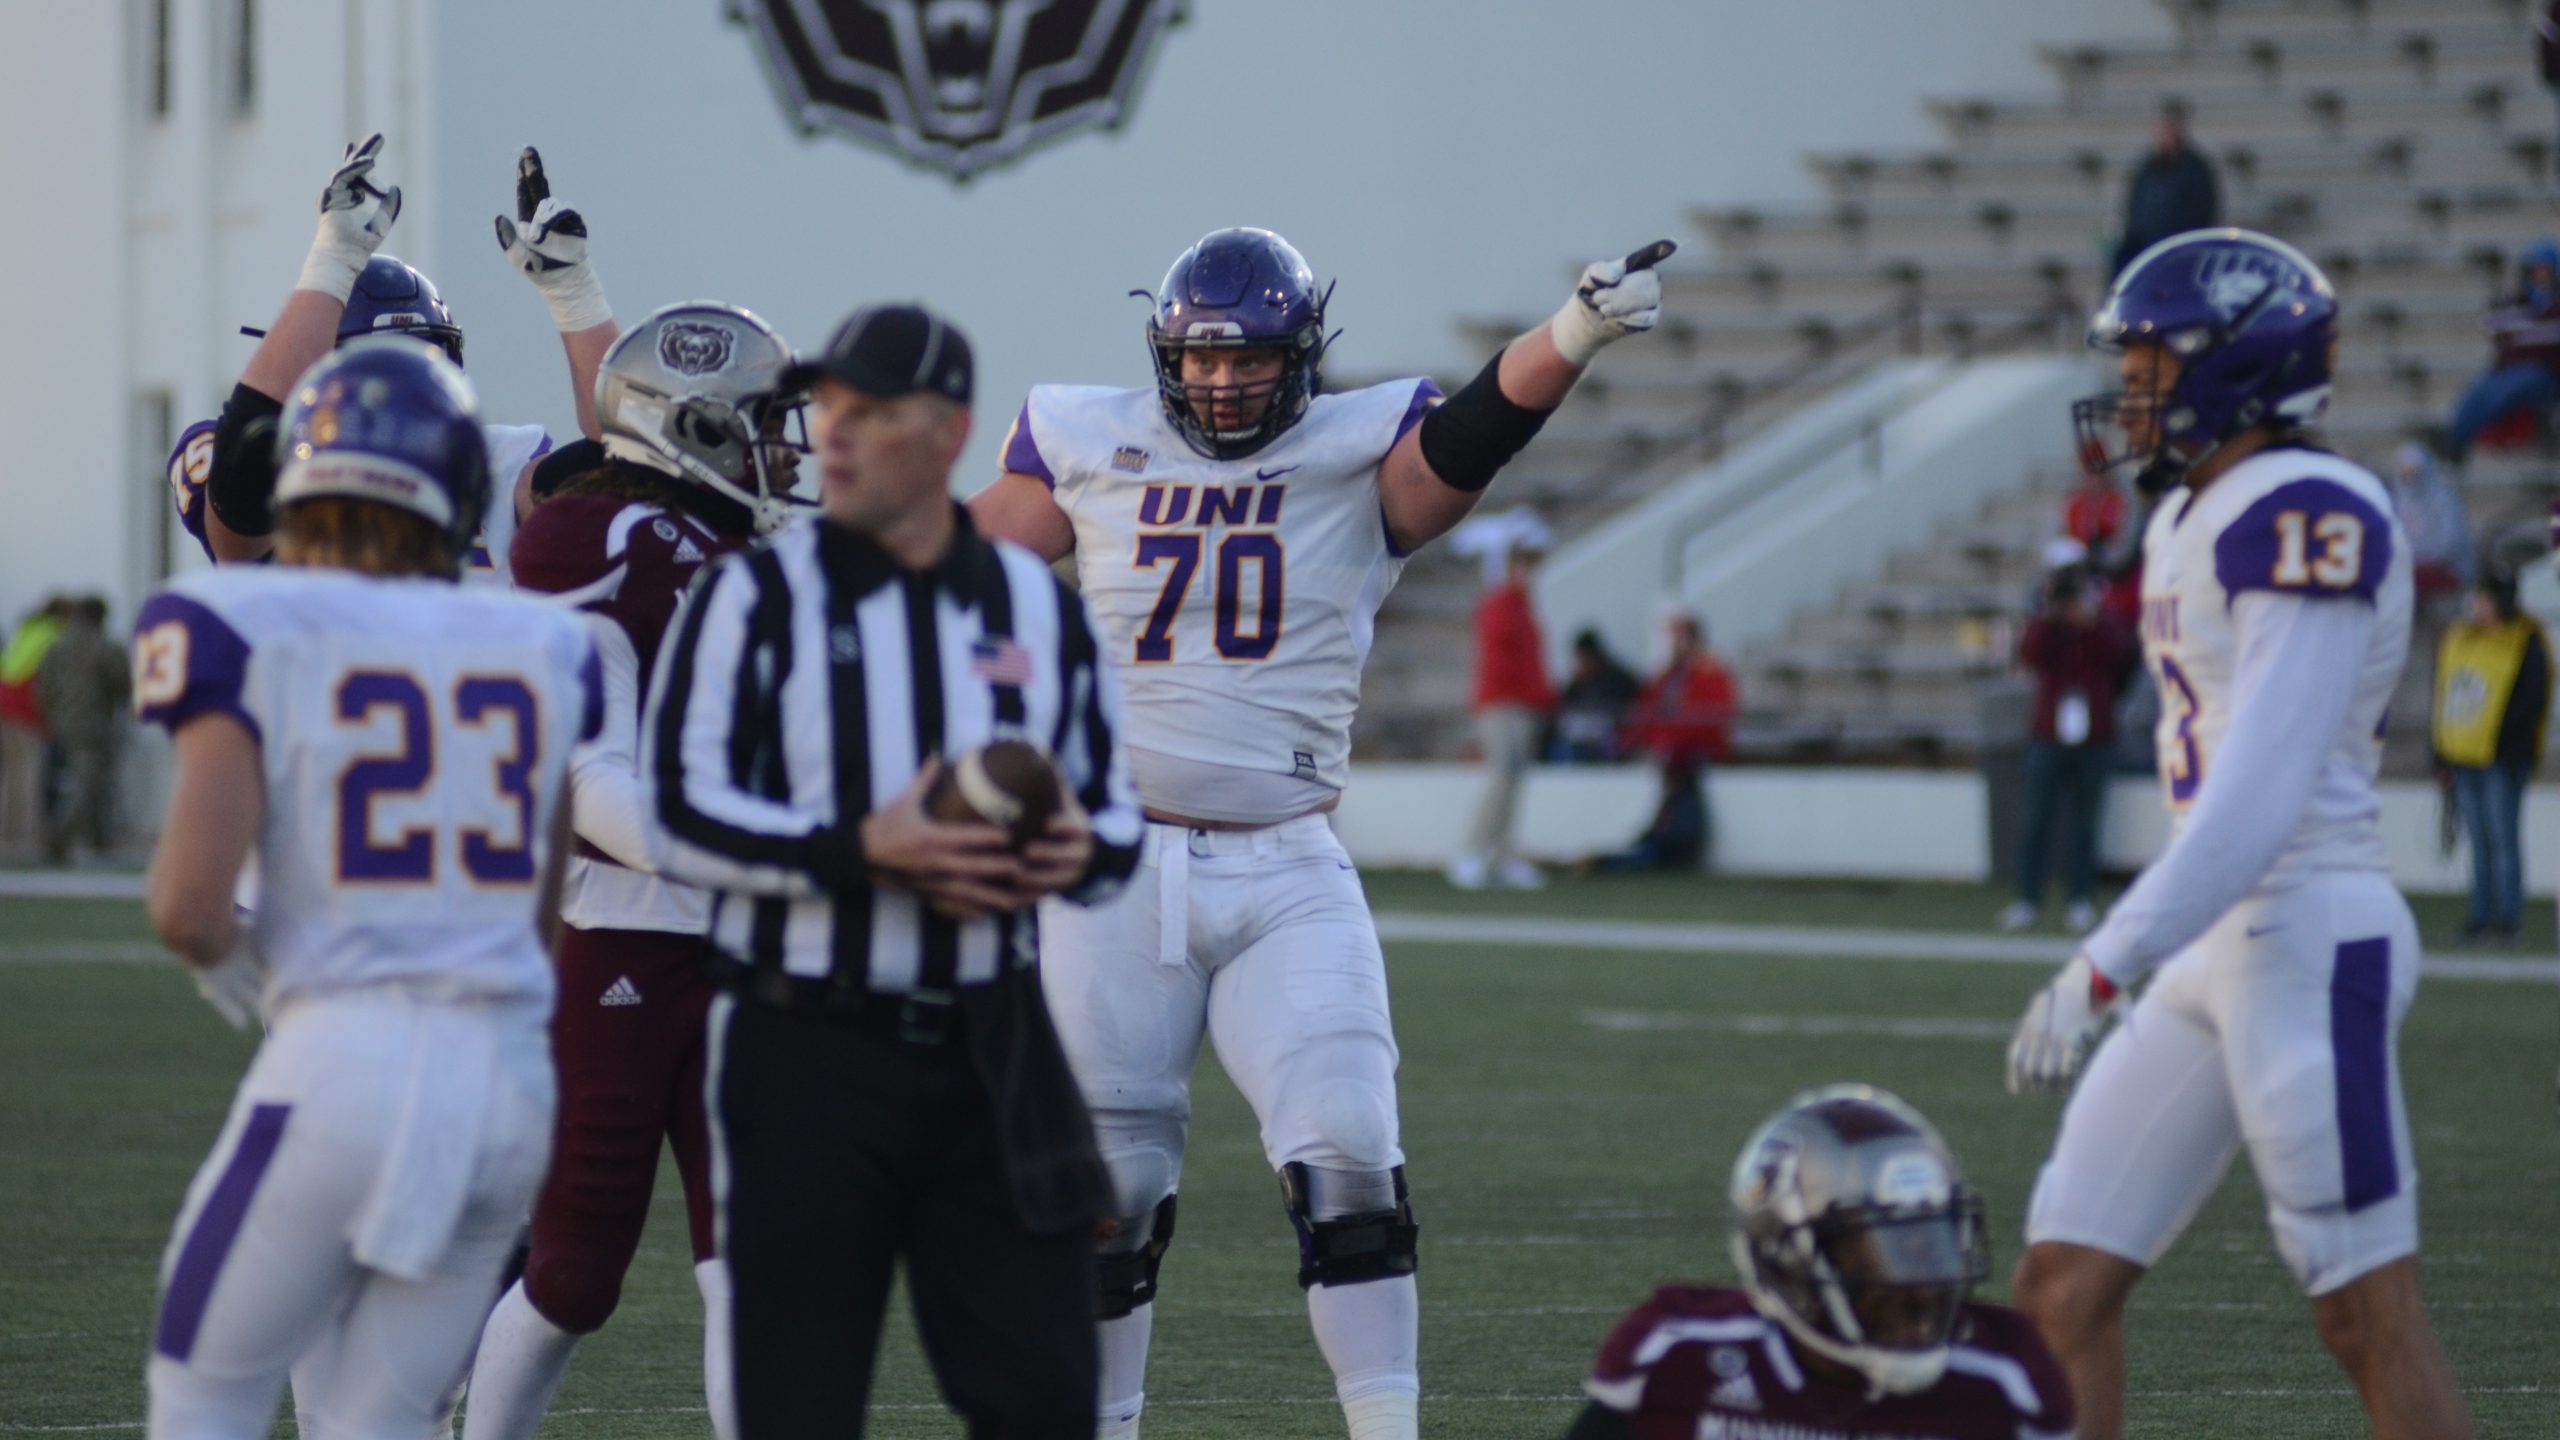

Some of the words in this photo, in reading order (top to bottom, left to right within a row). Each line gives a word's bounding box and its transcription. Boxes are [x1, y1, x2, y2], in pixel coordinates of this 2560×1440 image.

[1137, 483, 1288, 526] UNI
[2273, 510, 2364, 588] 13
[1133, 532, 1285, 665] 70
[330, 667, 540, 884] 23
